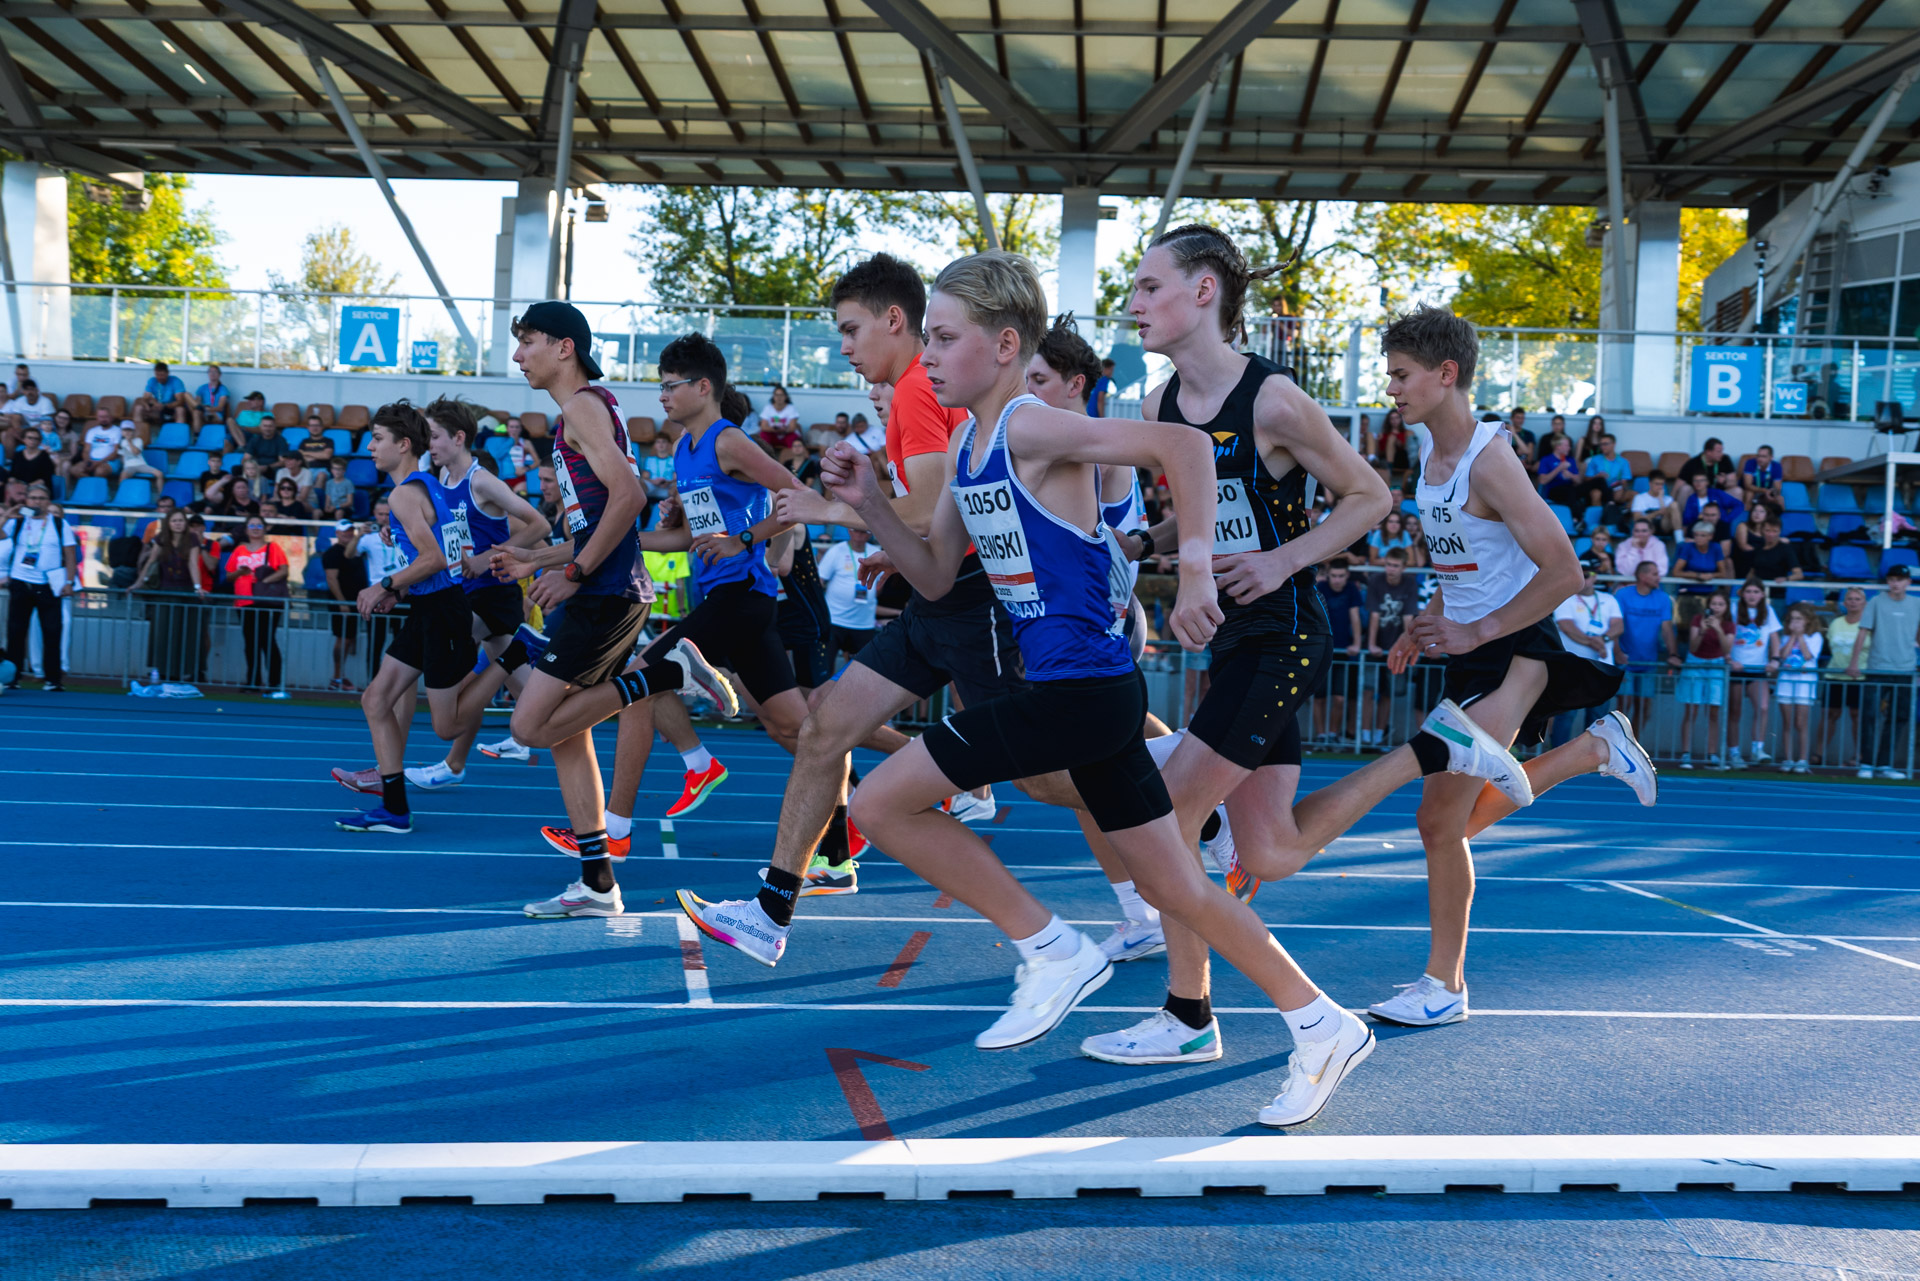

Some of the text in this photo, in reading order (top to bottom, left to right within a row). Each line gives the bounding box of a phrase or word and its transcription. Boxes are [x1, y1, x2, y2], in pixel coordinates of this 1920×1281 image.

[352, 310, 389, 320] SEKTOR
[349, 322, 387, 362] A
[413, 344, 437, 357] WC
[1705, 351, 1748, 361] SEKTOR
[1707, 364, 1741, 406] B
[1776, 387, 1803, 400] WC
[963, 487, 1011, 516] 1050
[1432, 506, 1452, 523] 475
[715, 913, 775, 944] new balance
